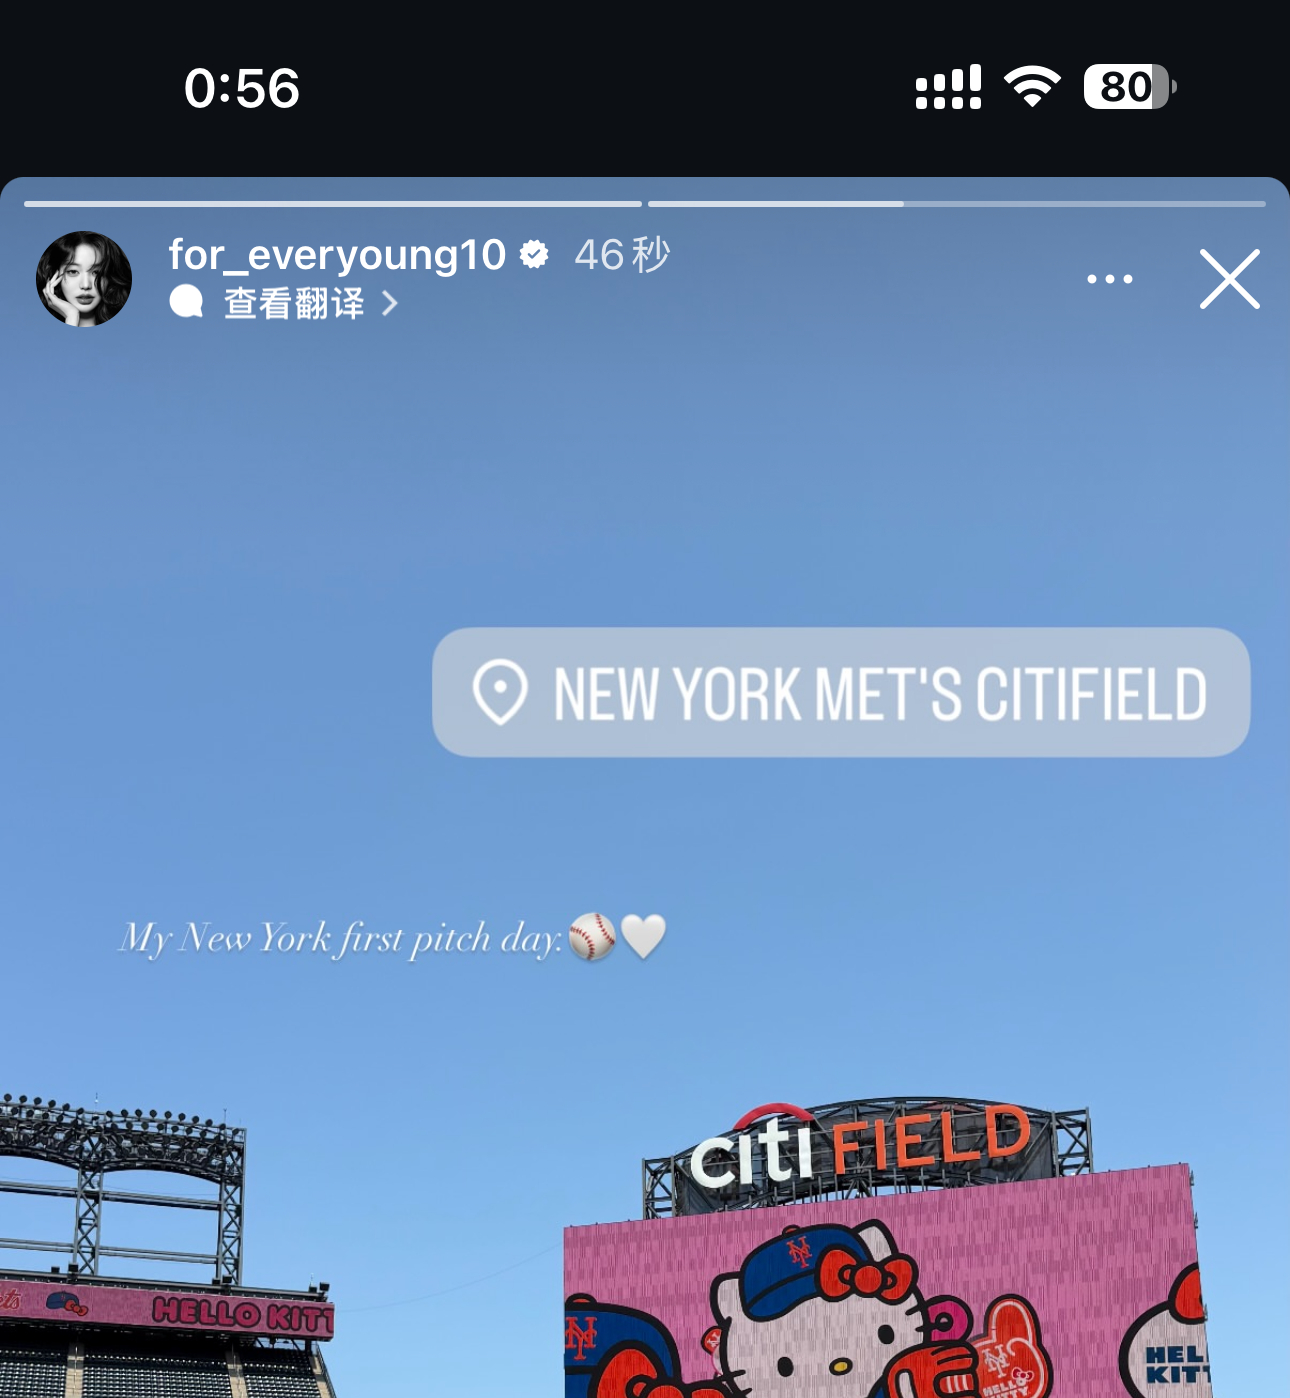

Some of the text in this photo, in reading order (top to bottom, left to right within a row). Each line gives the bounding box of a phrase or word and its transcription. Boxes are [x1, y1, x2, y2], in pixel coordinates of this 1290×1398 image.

[691, 1104, 1031, 1188] citi FIELD
[151, 1296, 262, 1328] HELLO
[1146, 1345, 1209, 1364] HEL
